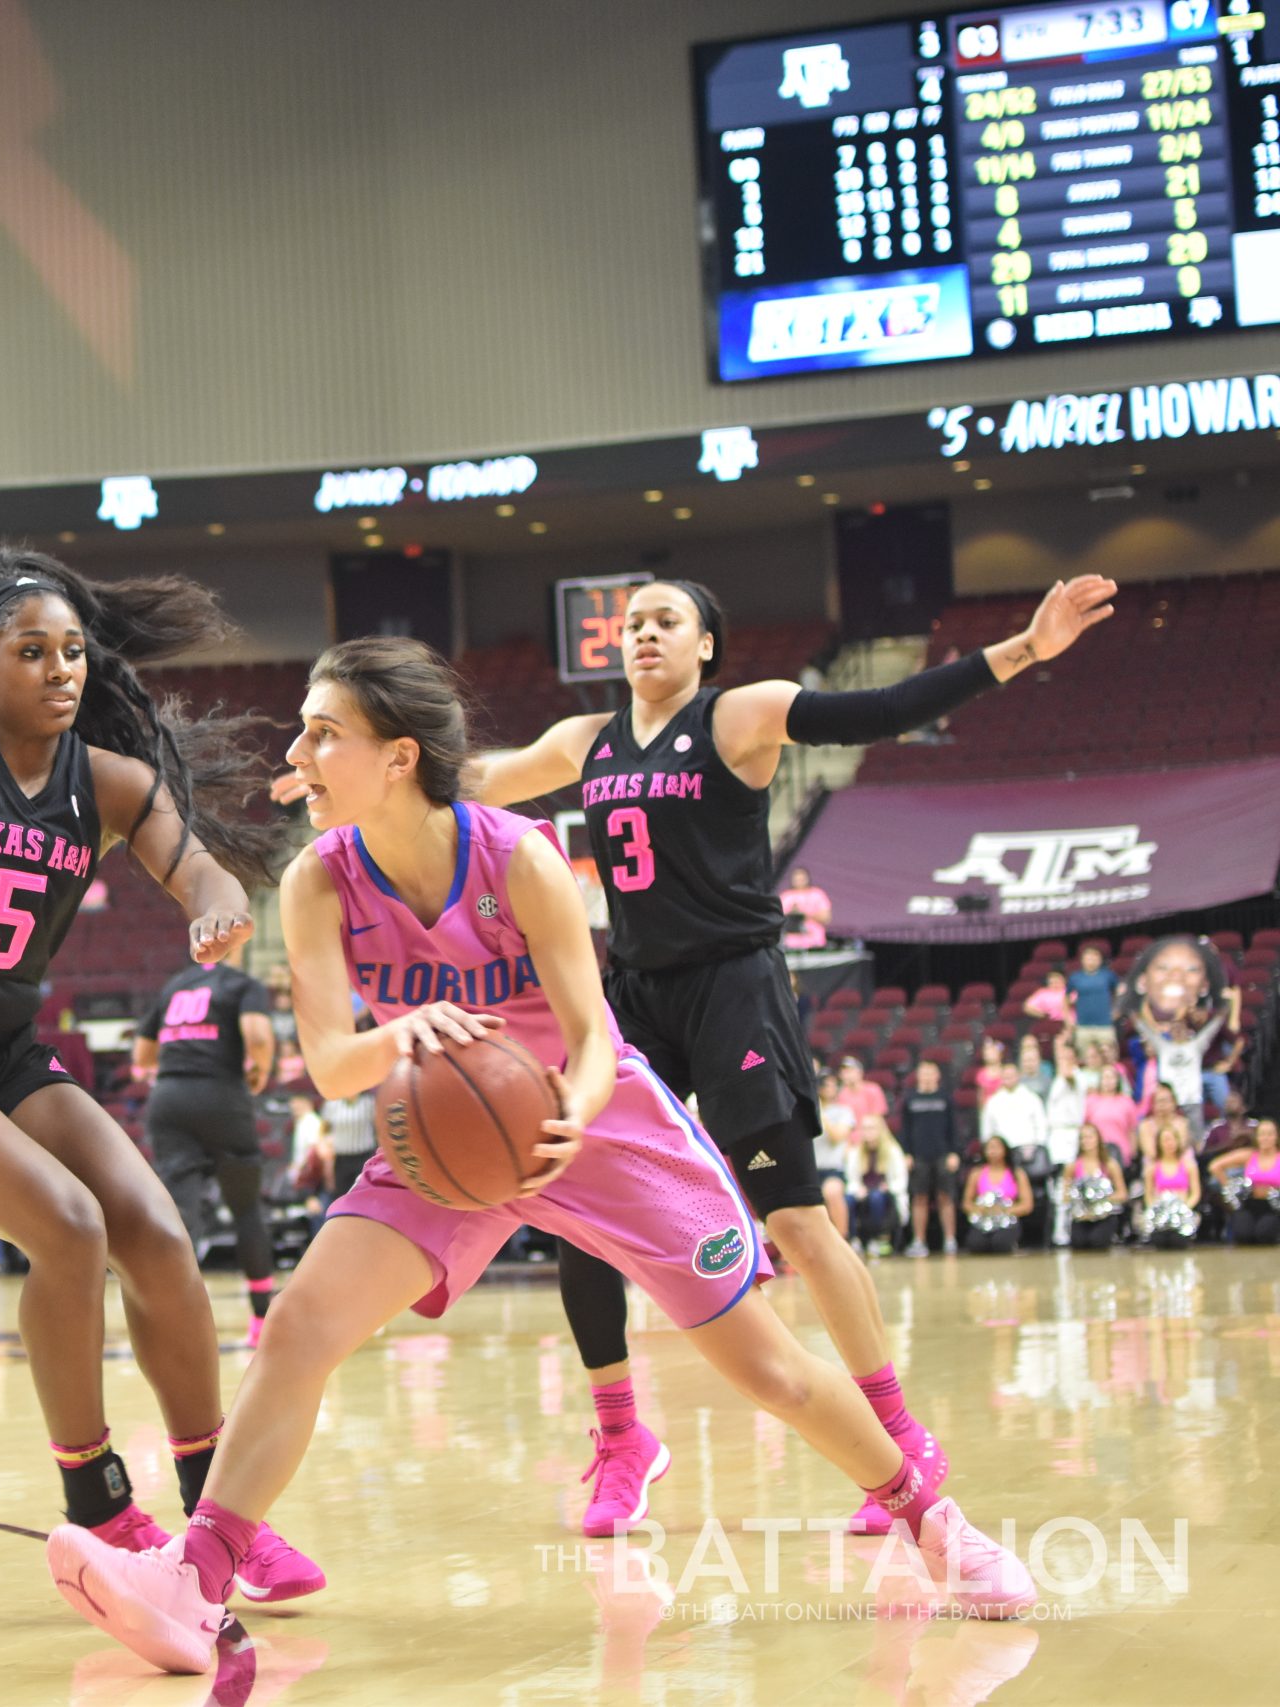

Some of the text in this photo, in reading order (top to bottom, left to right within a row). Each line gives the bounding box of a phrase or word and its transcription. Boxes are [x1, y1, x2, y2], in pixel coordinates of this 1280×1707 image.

[1075, 7, 1144, 39] 7:33
[581, 771, 704, 810] TEXAS A&M
[47, 835, 92, 879] A&M
[606, 806, 656, 893] 3
[354, 952, 542, 1007] FLORIDA
